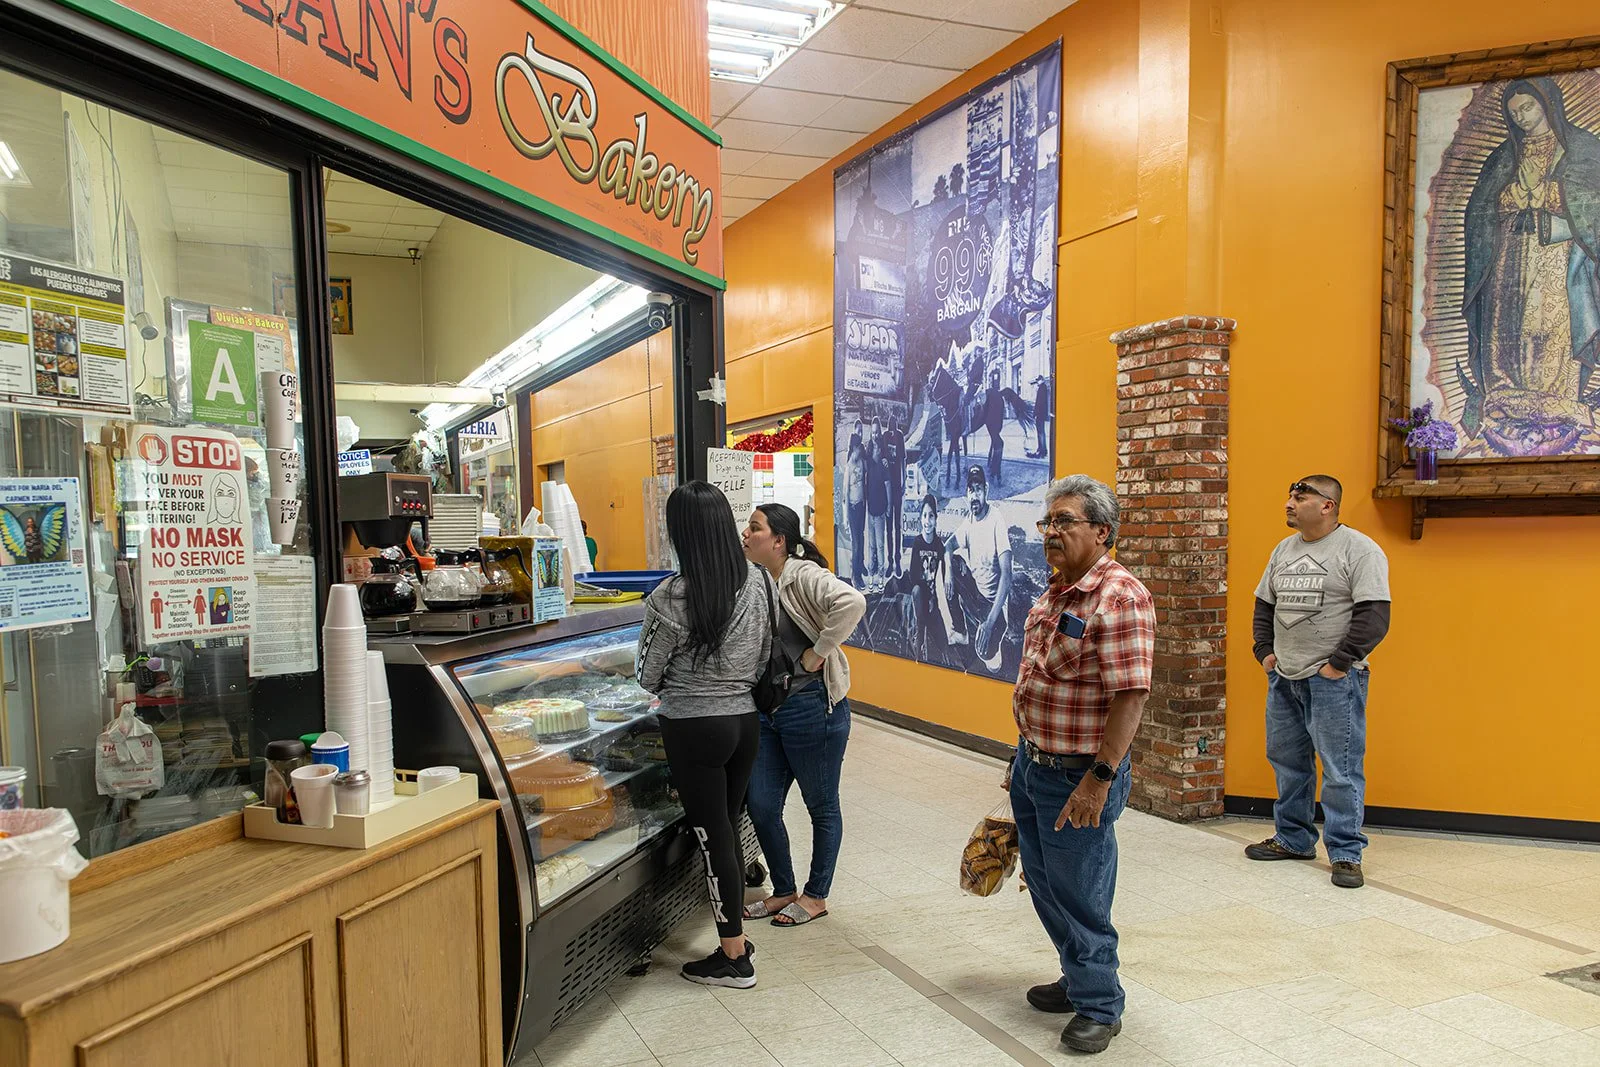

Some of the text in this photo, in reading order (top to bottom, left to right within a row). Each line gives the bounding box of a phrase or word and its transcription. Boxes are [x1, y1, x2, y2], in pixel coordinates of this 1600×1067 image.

[236, 0, 472, 125] AN'S
[495, 32, 713, 266] Bakery
[30, 266, 43, 276] LAS
[43, 270, 73, 283] ALERGIAS
[77, 277, 89, 288] LOS
[88, 280, 122, 293] ALIMENTOS
[46, 279, 108, 299] PUEDEN SER GRAVES
[937, 296, 981, 323] BARGAIN
[216, 312, 285, 331] Vivian's Bakery
[848, 351, 889, 367] NATURALES
[205, 347, 246, 405] A
[460, 421, 497, 435] LERIA
[177, 439, 238, 467] STOP
[710, 451, 752, 465] ACEPTAMOS
[52, 483, 63, 491] DEL
[143, 472, 203, 486] YOU MUST
[713, 479, 745, 493] ZELLE
[179, 488, 204, 499] YOUR
[146, 501, 205, 511] FACE BEFORE
[147, 513, 197, 524] ENTERING!
[151, 527, 245, 548] NO MASK
[152, 550, 246, 568] NO SERVICE
[174, 567, 227, 578] (NO EXCEPTIONS)
[1277, 577, 1324, 589] VOLCOM
[693, 827, 728, 923] PINK
